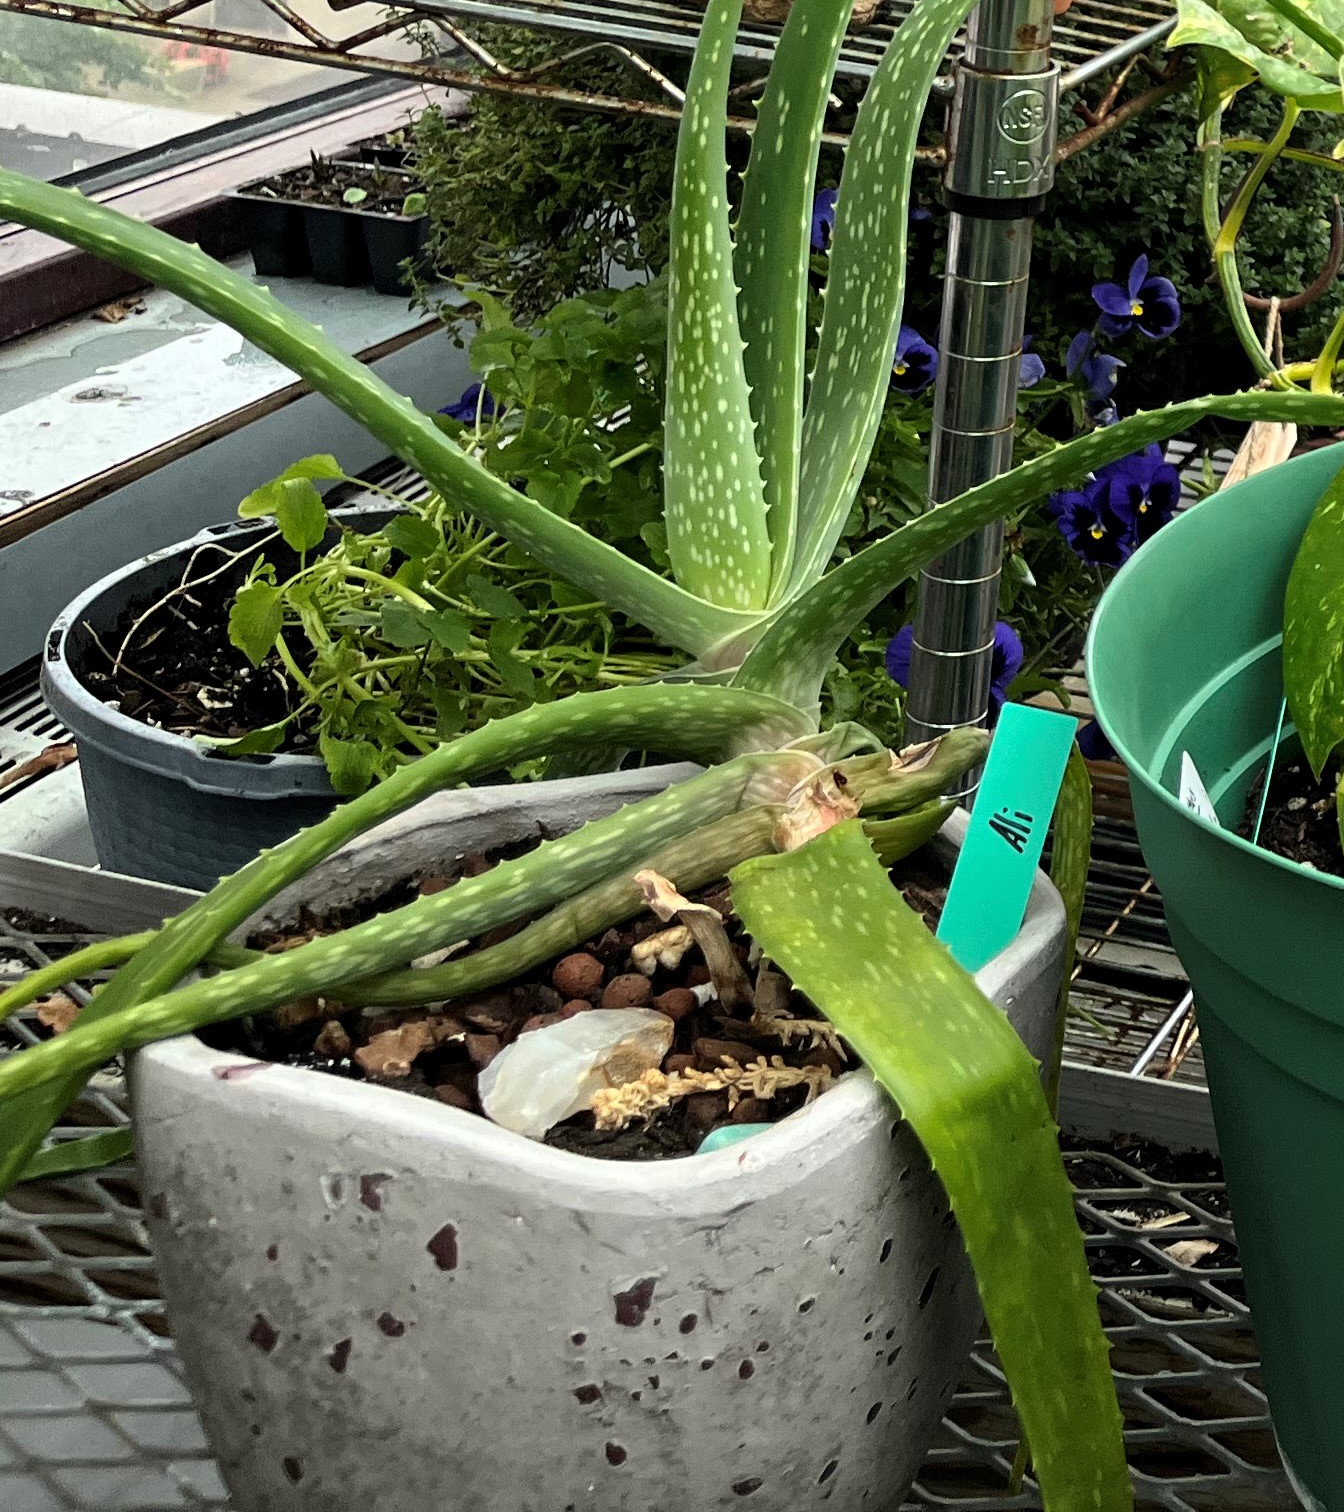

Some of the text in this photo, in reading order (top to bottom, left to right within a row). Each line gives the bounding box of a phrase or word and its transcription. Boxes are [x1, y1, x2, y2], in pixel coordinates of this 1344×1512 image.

[1004, 106, 1044, 130] NSF
[988, 154, 1051, 185] HDX
[988, 807, 1033, 854] Ali
